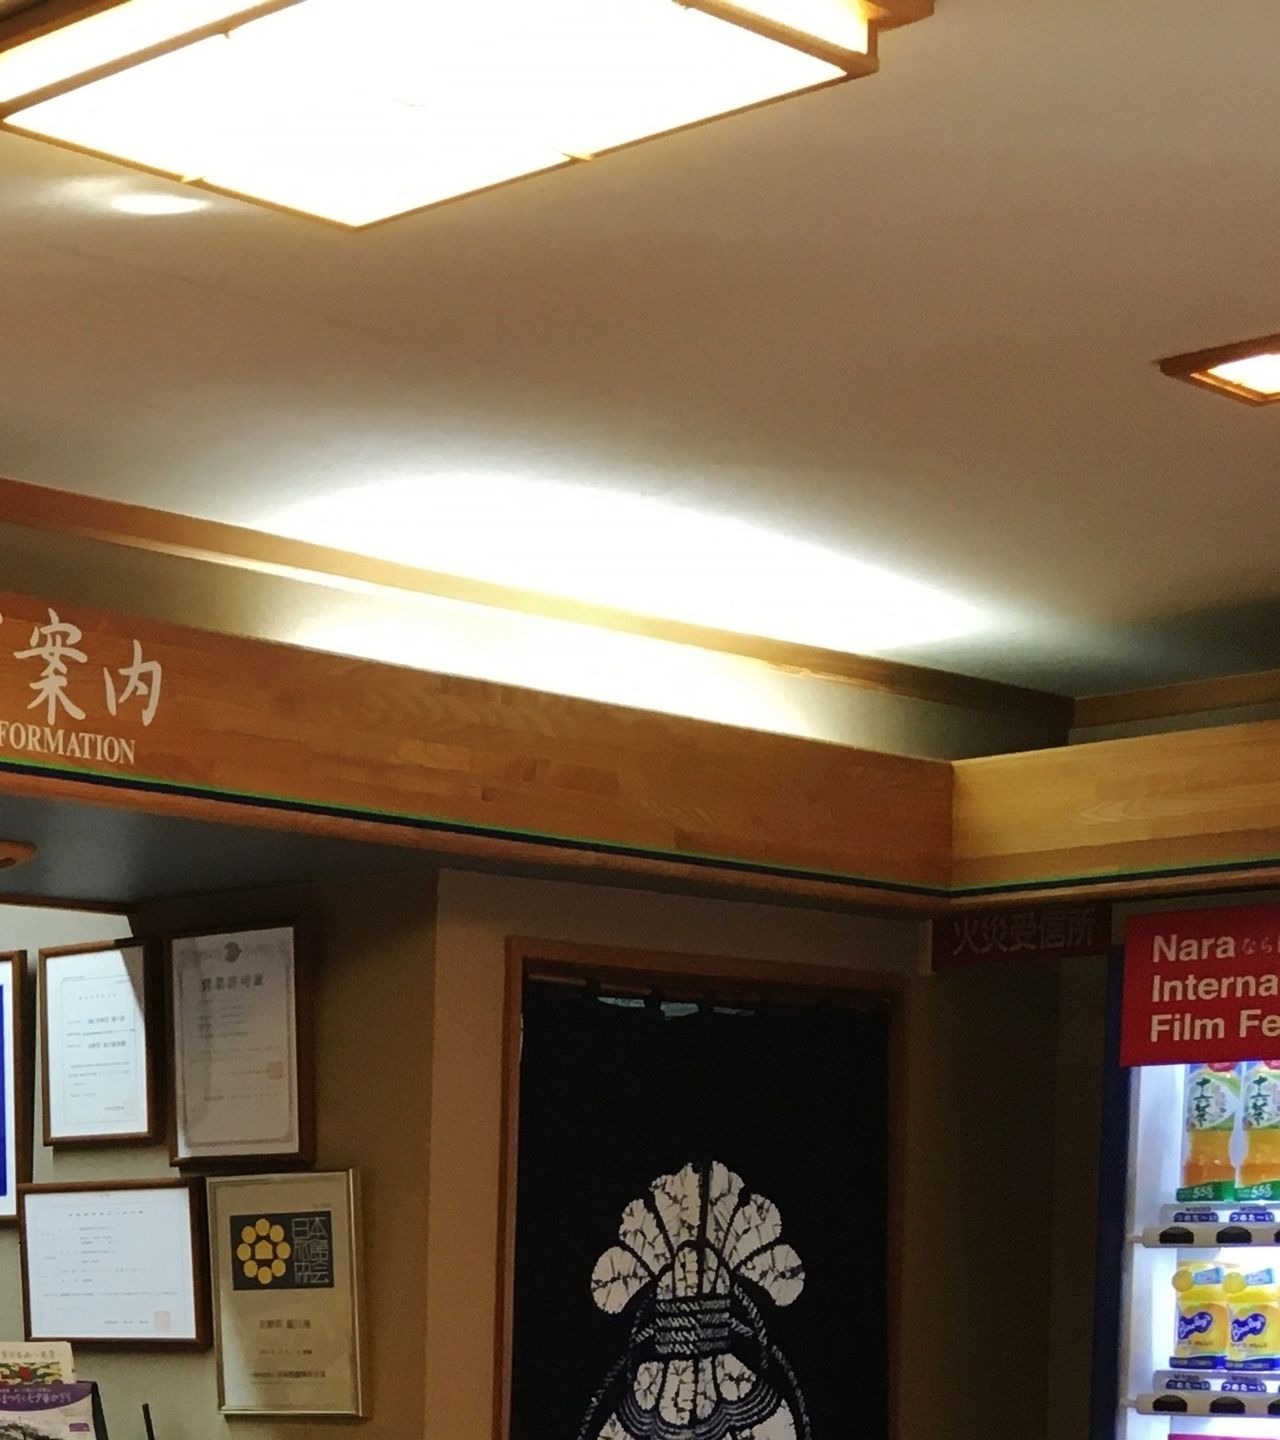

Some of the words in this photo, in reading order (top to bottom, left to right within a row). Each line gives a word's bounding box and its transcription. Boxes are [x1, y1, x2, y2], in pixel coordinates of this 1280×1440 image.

[951, 908, 1097, 957] 火災受信所
[1152, 933, 1236, 963] Nara
[1151, 973, 1279, 1003] Interna
[1150, 1012, 1225, 1042] Film
